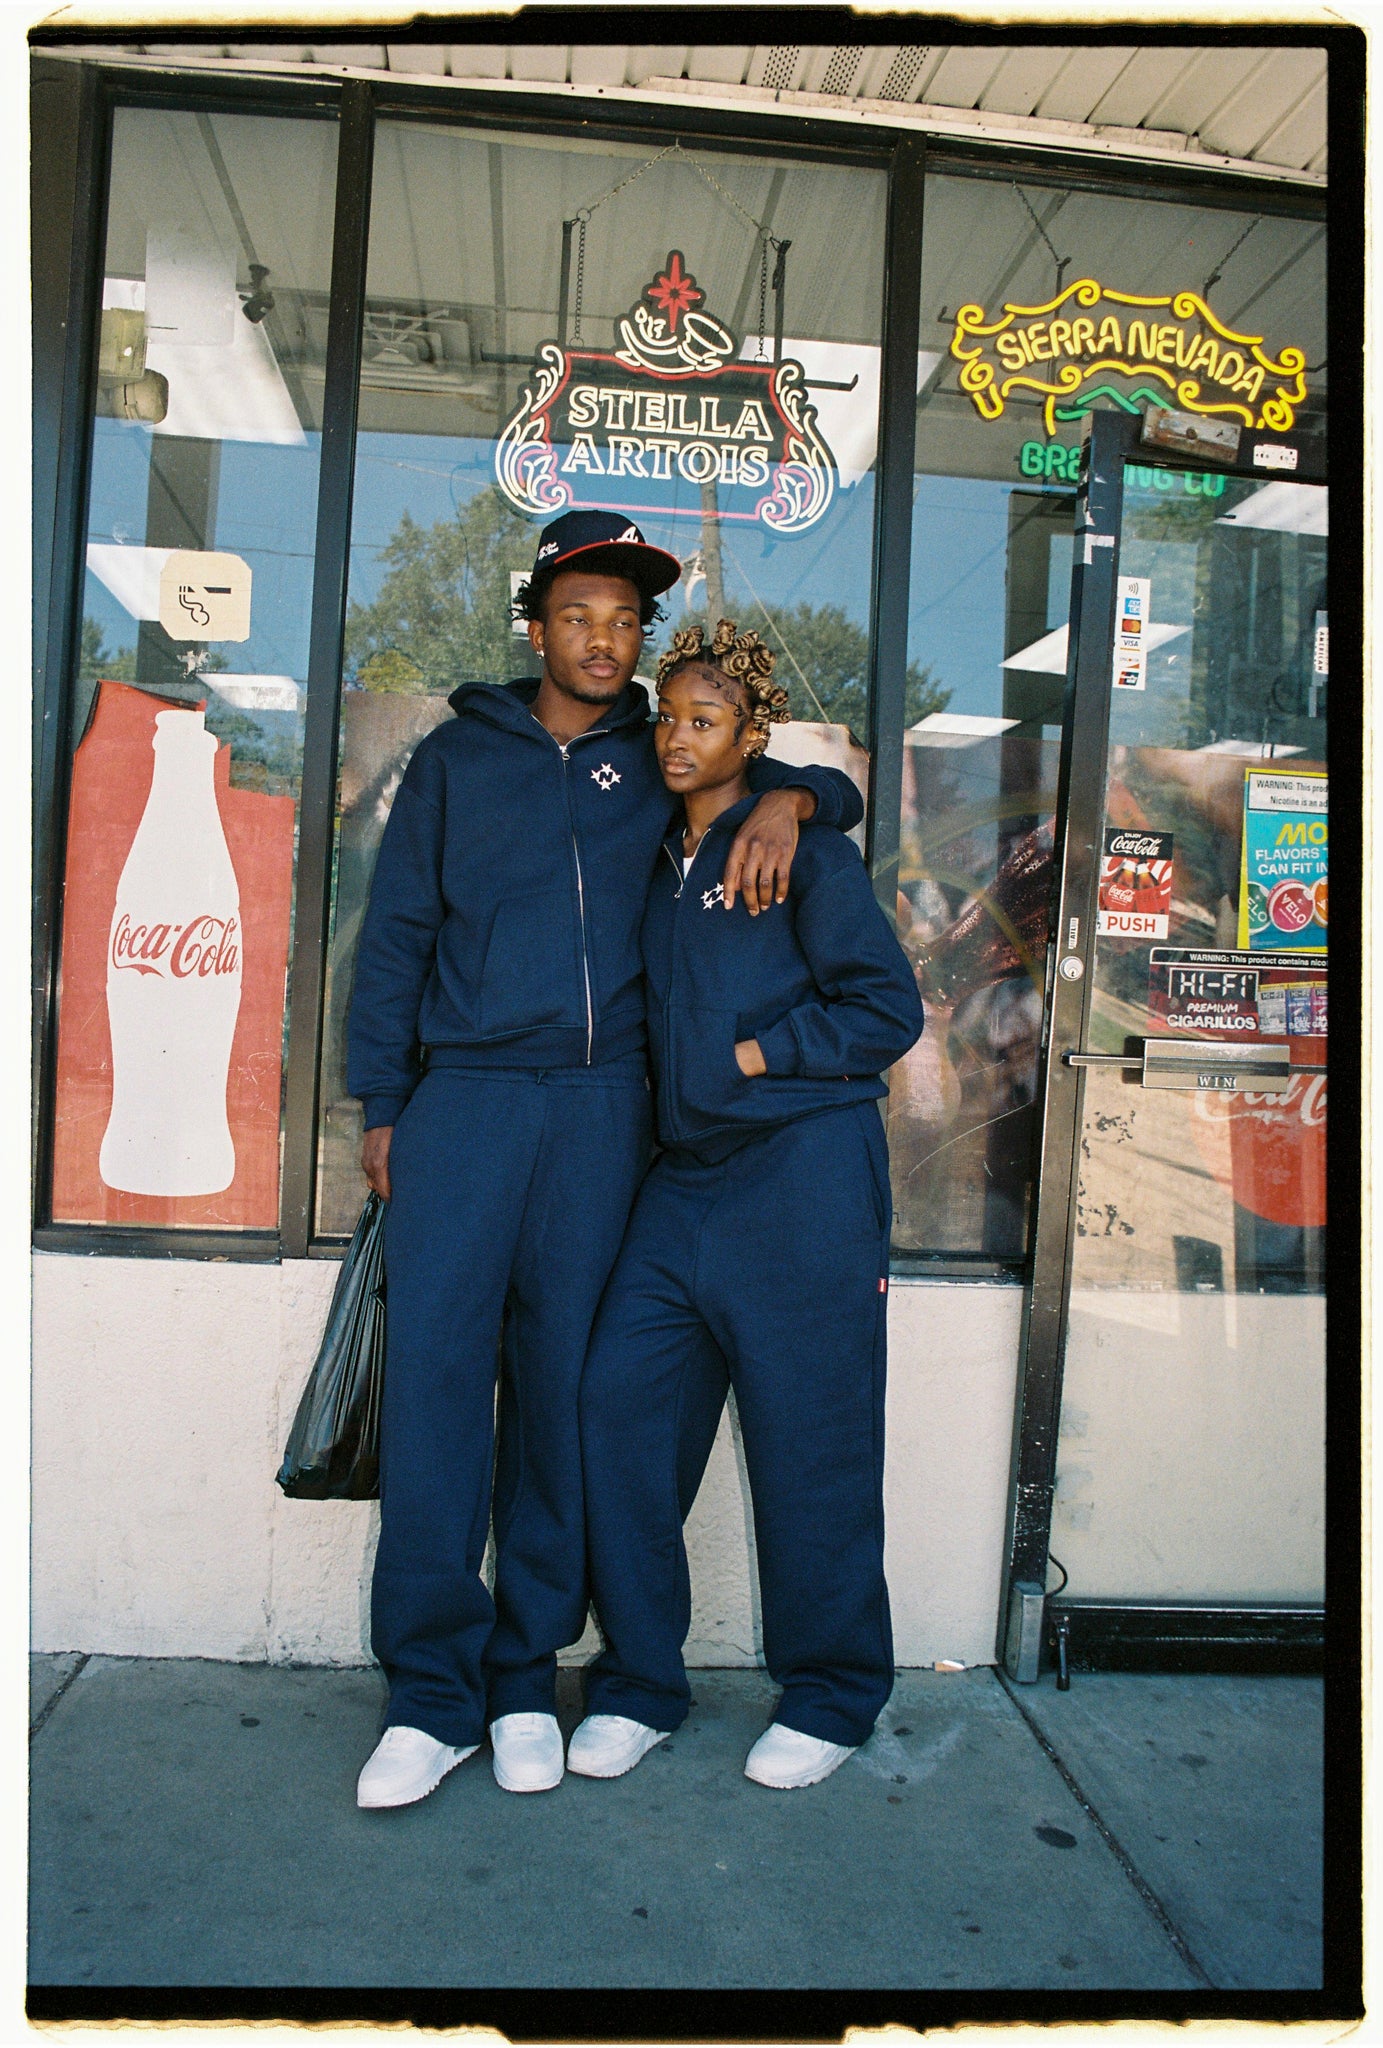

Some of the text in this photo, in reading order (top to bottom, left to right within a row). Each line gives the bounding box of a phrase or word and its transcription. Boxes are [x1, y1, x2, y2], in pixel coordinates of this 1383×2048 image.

[996, 316, 1265, 402] SIERRA NEVADA
[568, 386, 774, 441] STELLA
[561, 433, 770, 487] ARTOIS
[1123, 639, 1139, 647] VISA
[1296, 782, 1311, 791] This
[1270, 796, 1299, 806] Nicotine
[1110, 835, 1163, 856] Coca-Cola
[1255, 847, 1320, 861] FLAVORS
[1258, 863, 1288, 875] CAN
[1292, 862, 1312, 874] FIT
[1248, 897, 1268, 922] ELO
[1281, 893, 1307, 924] VELO
[1107, 916, 1156, 932] PUSH
[112, 913, 238, 979] Coca-Cola
[1189, 953, 1229, 963] WARNING:
[1231, 955, 1246, 963] This
[1248, 956, 1276, 965] product
[1278, 957, 1309, 966] contains
[1179, 971, 1248, 998] HI-FI
[1187, 1003, 1239, 1013] PREMIUM
[1166, 1014, 1257, 1031] CIGARILLOS
